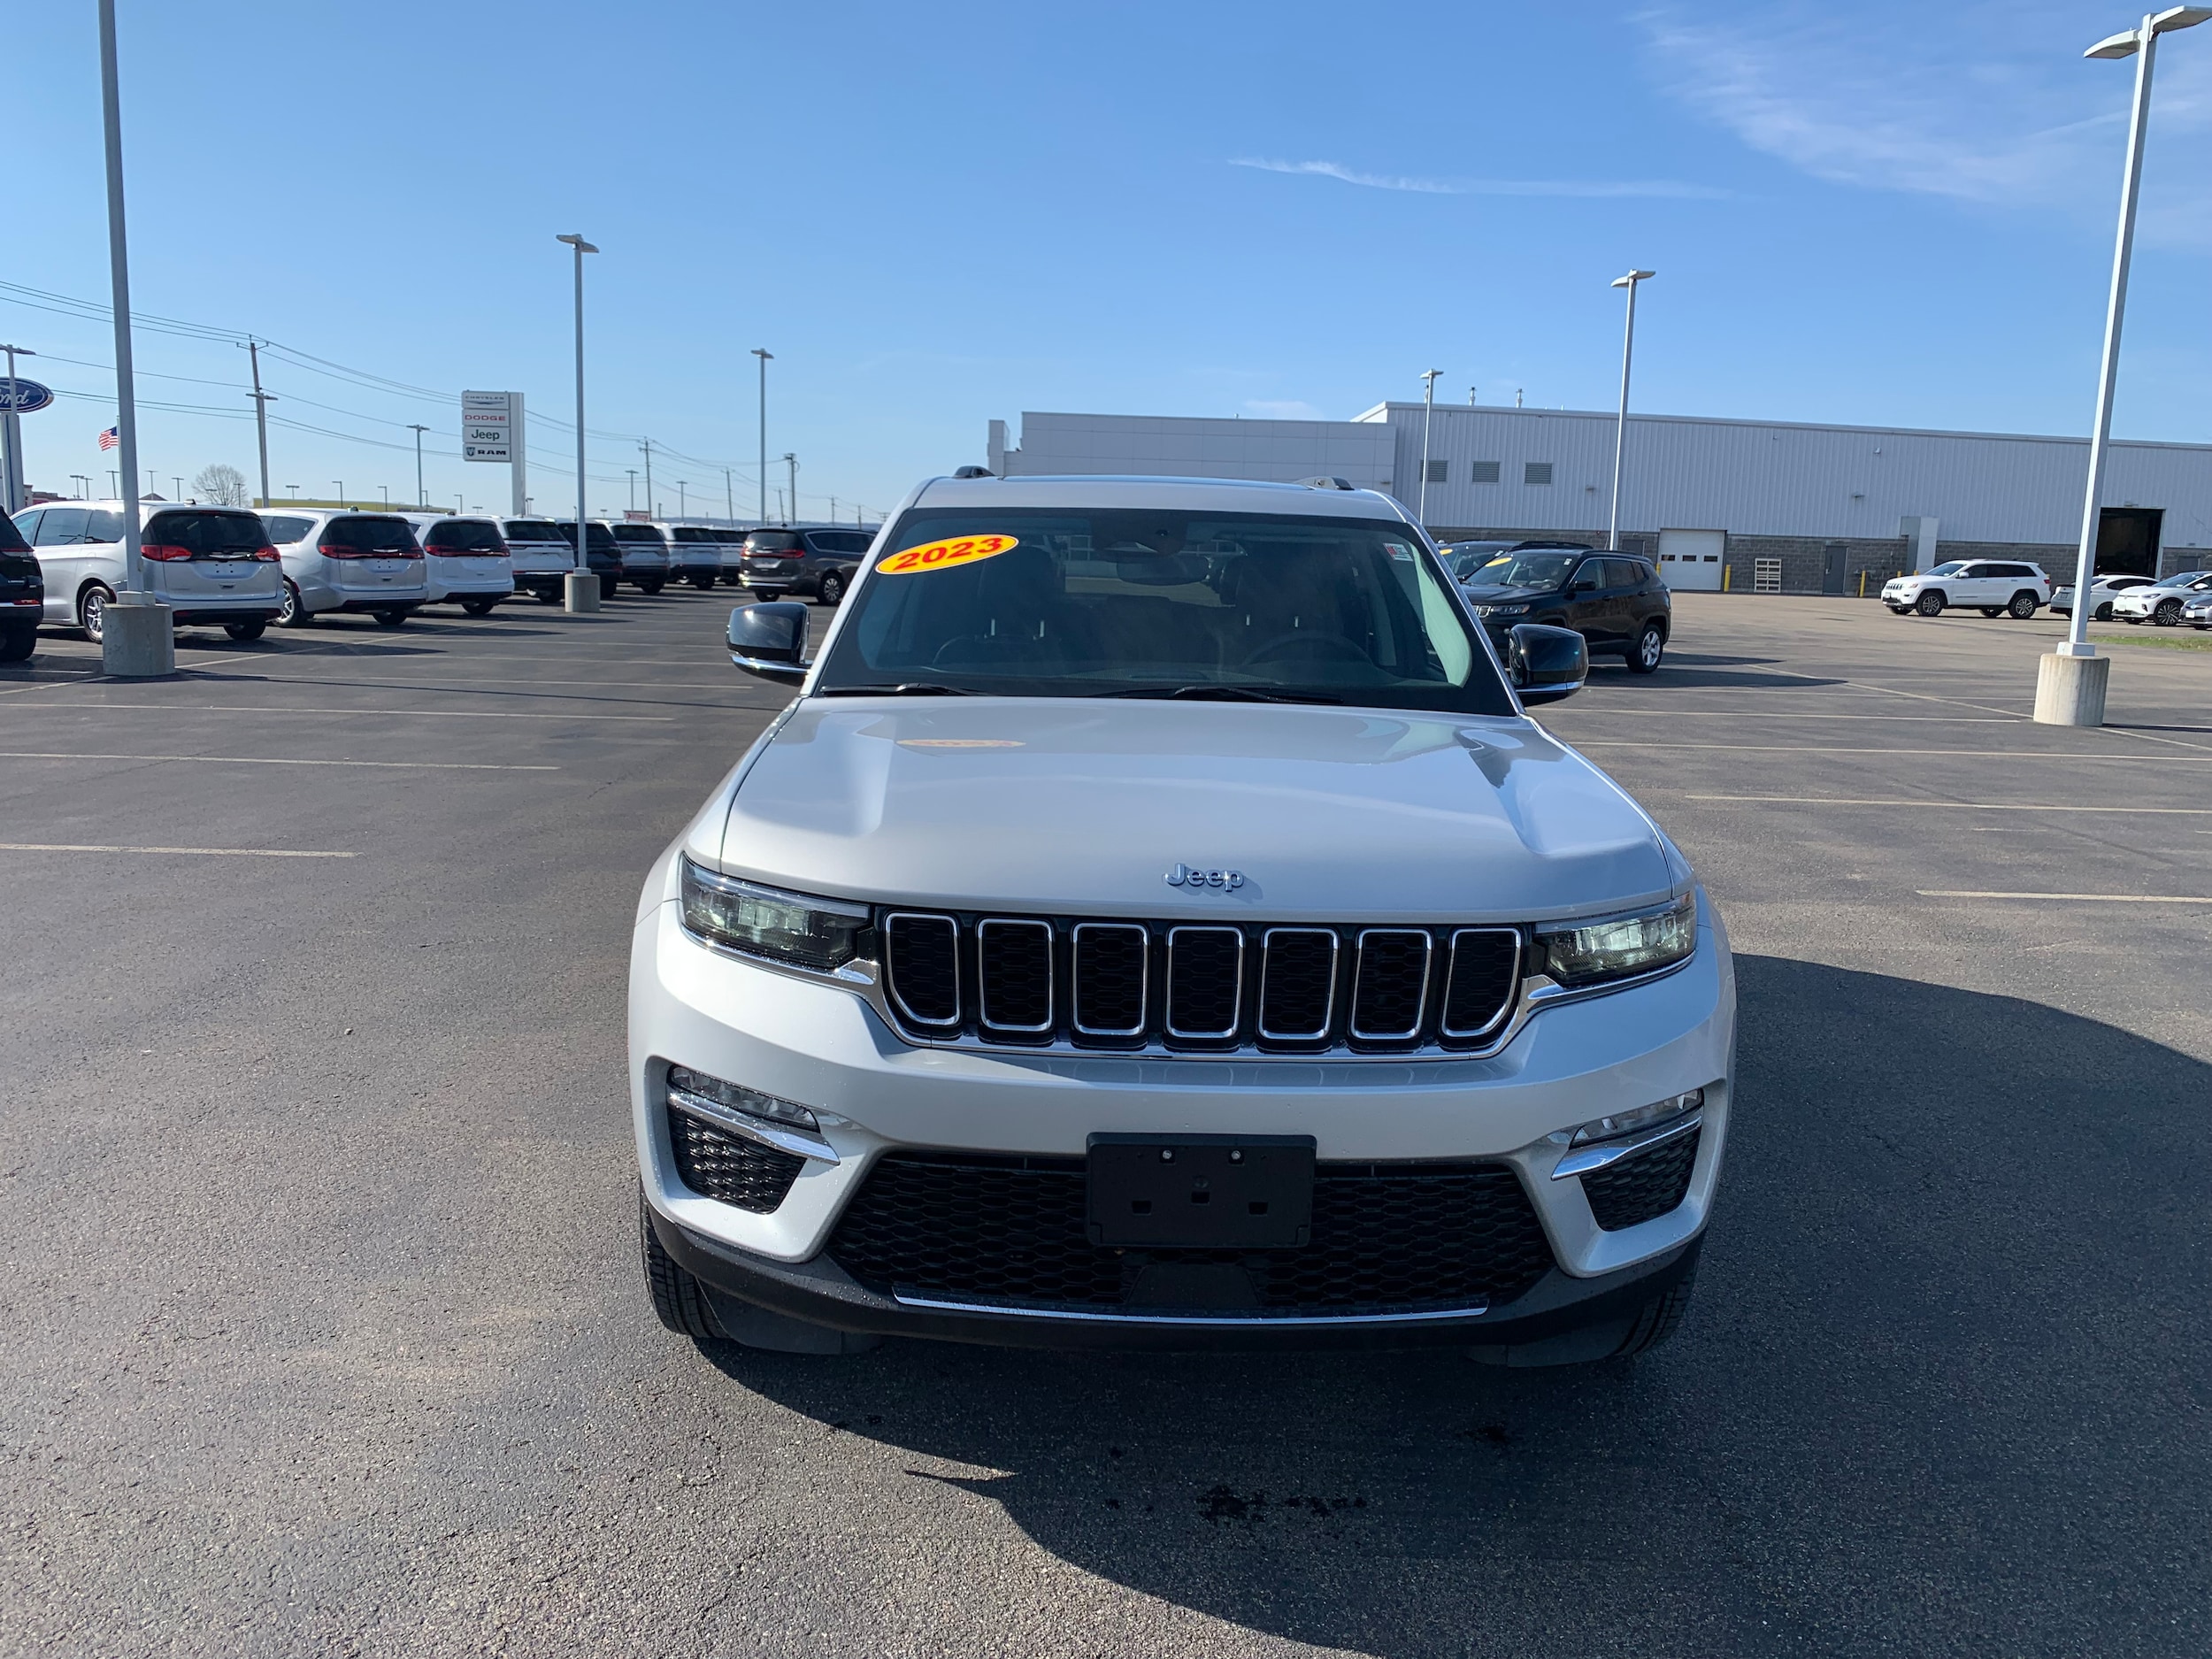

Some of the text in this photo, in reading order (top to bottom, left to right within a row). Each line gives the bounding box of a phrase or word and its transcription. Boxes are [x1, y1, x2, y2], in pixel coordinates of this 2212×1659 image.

[471, 428, 500, 442] Jeep
[893, 537, 1002, 572] 2023
[1164, 863, 1245, 893] Jeep
